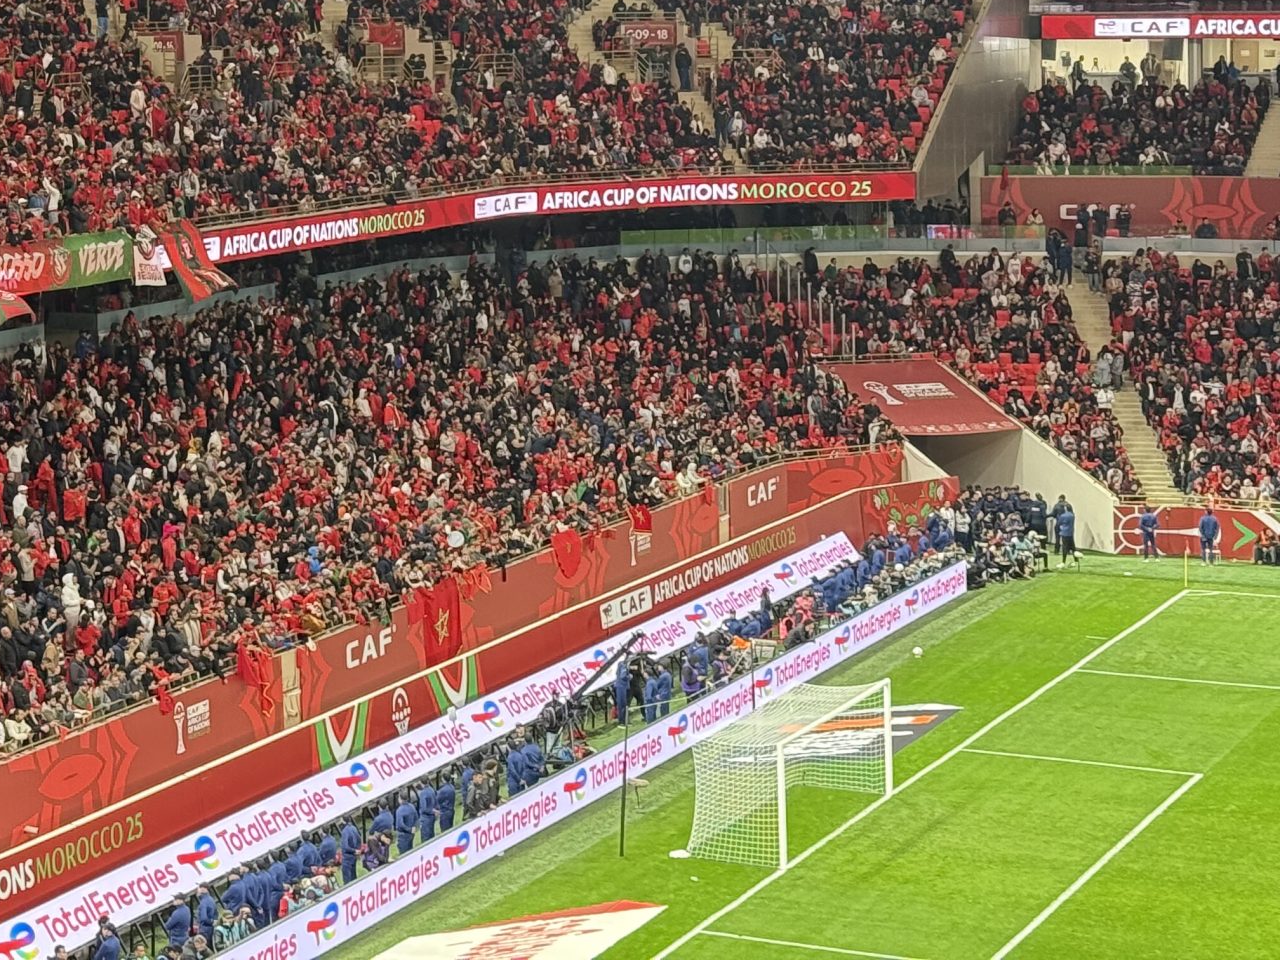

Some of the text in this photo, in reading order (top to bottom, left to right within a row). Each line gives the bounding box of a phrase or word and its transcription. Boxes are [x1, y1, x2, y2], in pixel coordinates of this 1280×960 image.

[1131, 21, 1179, 33] CAF
[1195, 19, 1257, 35] AFRICA
[494, 180, 872, 213] CAF AFRICA CUP OF NATIONS MOROCCO 25
[223, 230, 270, 257] AFRICA
[269, 228, 292, 249] CUP
[293, 225, 311, 247] OF
[311, 218, 359, 242] NATIONS
[358, 211, 413, 235] MOROCCO
[413, 208, 425, 226] 25
[79, 238, 125, 276] VERDE
[747, 477, 777, 507] CAF
[619, 526, 796, 617] CAF AFRICA CUP OF NATIONS MOROCCO 25
[346, 626, 393, 669] CAF
[35, 865, 180, 943] TotalEnergies
[215, 785, 335, 856] TotalEnergies
[369, 721, 471, 782] TotalEnergies
[791, 540, 854, 578] TotalEnergies
[341, 569, 965, 926] TotalEnergies TotalEnergies TotalEnergies TotalEnergies TotalEnergies TotalEnergies TotalEnergies
[34, 821, 124, 884] MOROCCO
[125, 811, 144, 843] 25
